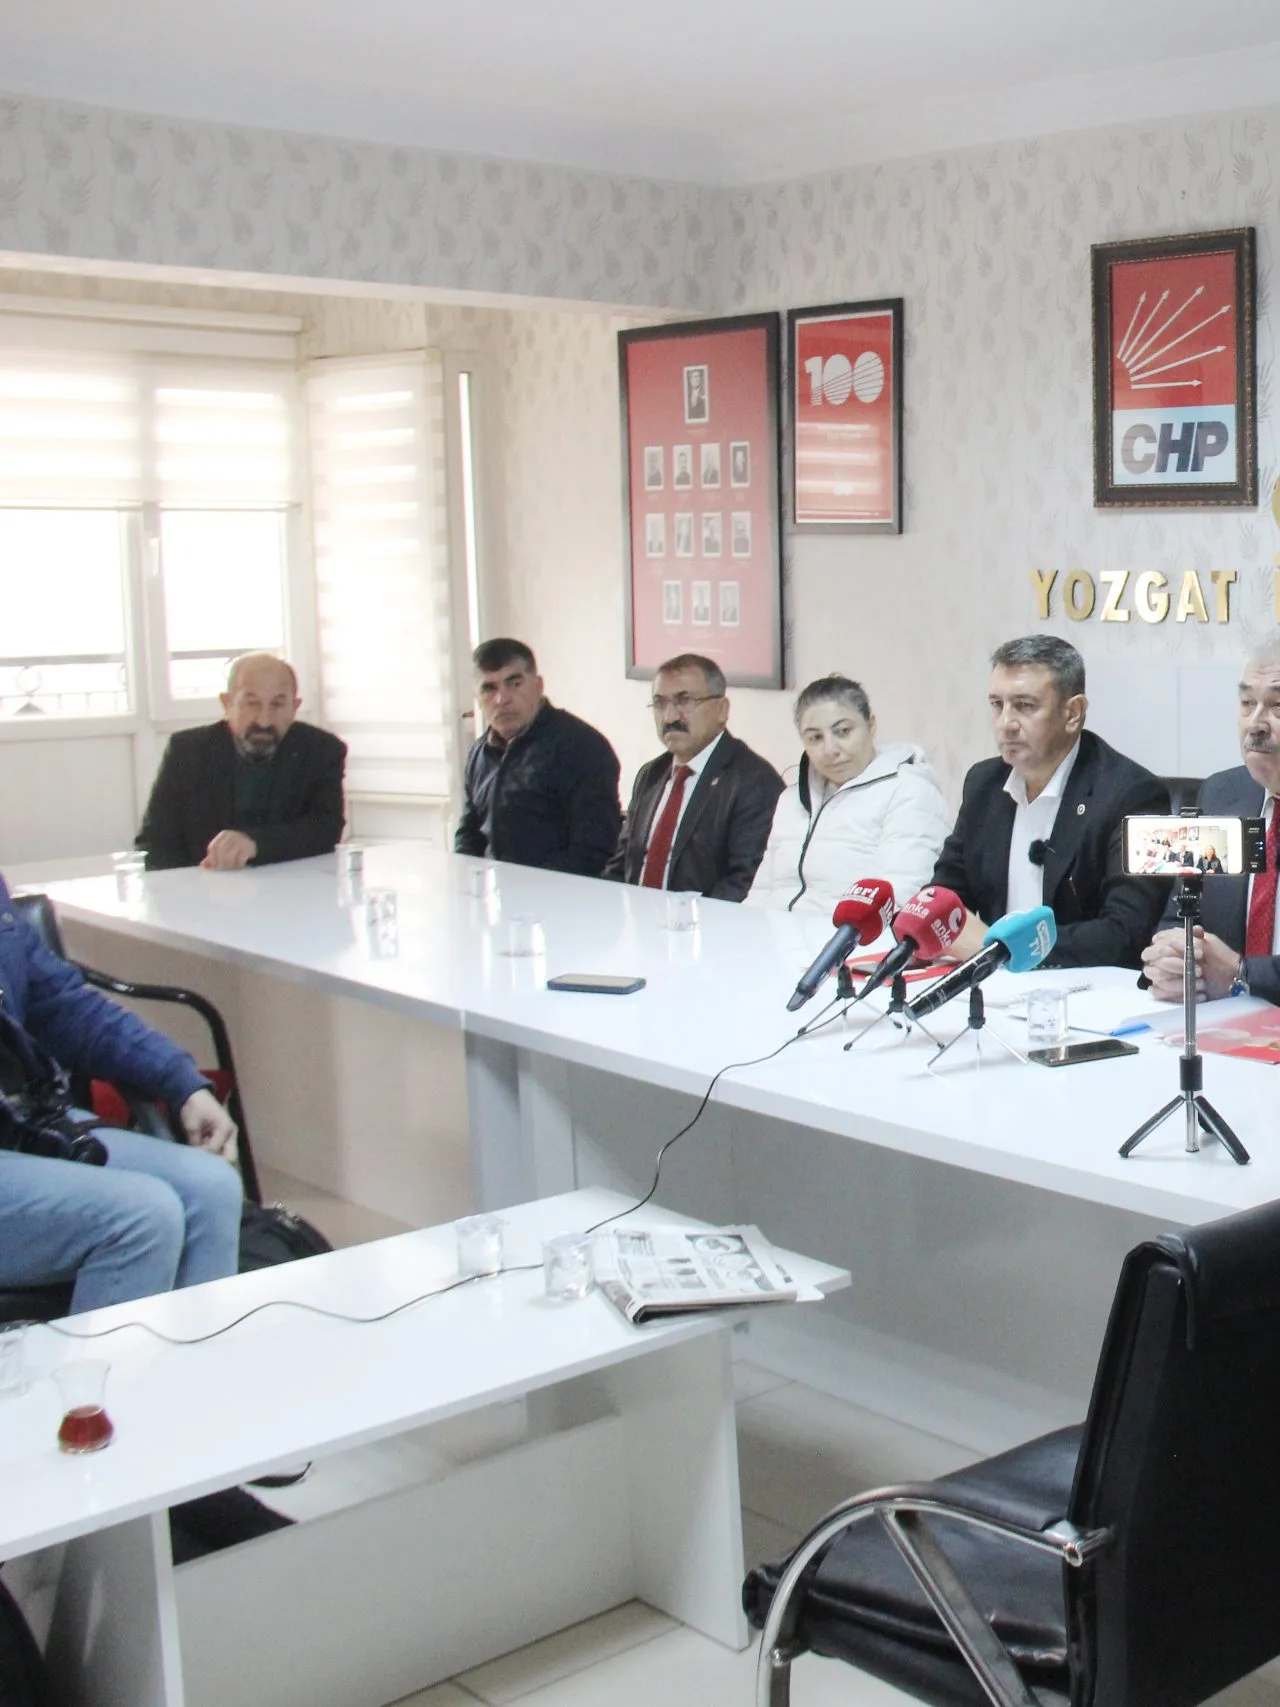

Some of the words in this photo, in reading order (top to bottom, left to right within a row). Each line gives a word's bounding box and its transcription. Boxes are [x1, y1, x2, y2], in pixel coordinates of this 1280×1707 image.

[803, 351, 884, 406] 100
[1120, 420, 1230, 474] CHP
[1029, 569, 1239, 623] YOZGAT
